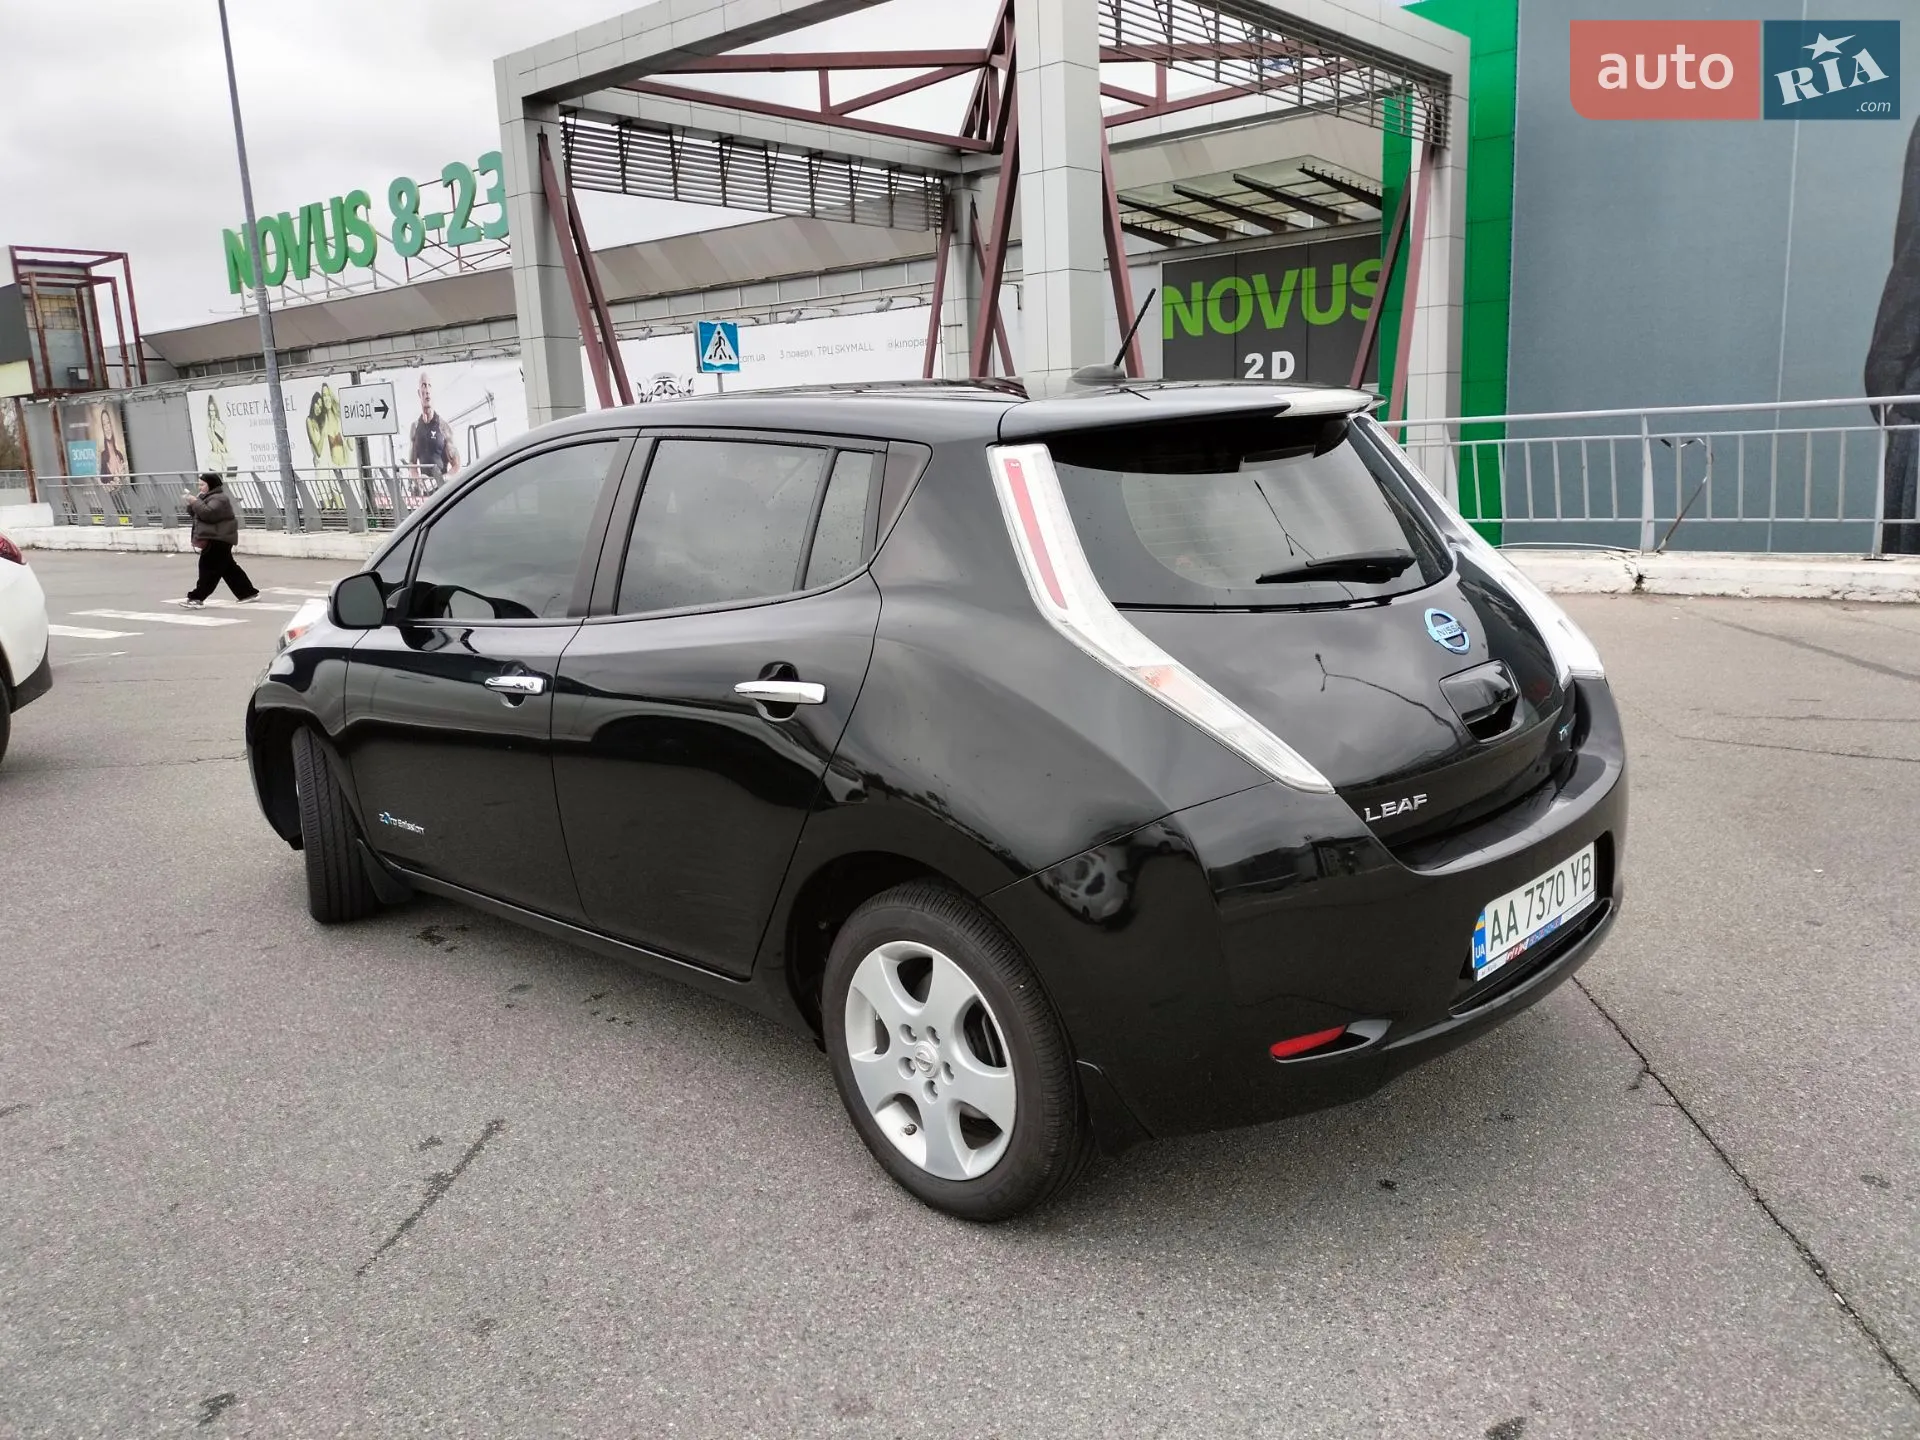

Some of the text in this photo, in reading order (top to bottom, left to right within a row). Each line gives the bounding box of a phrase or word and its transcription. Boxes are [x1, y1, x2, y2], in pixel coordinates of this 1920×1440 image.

[222, 151, 509, 294] NOVUS 8-23
[1163, 258, 1383, 340] NOVUS
[835, 342, 874, 354] SKYMALL
[263, 395, 297, 414] AEL
[1364, 793, 1428, 822] LEAF
[1489, 900, 1519, 953] AA
[1524, 870, 1566, 929] 7370
[1571, 852, 1591, 897] YB
[1475, 944, 1486, 959] UA
